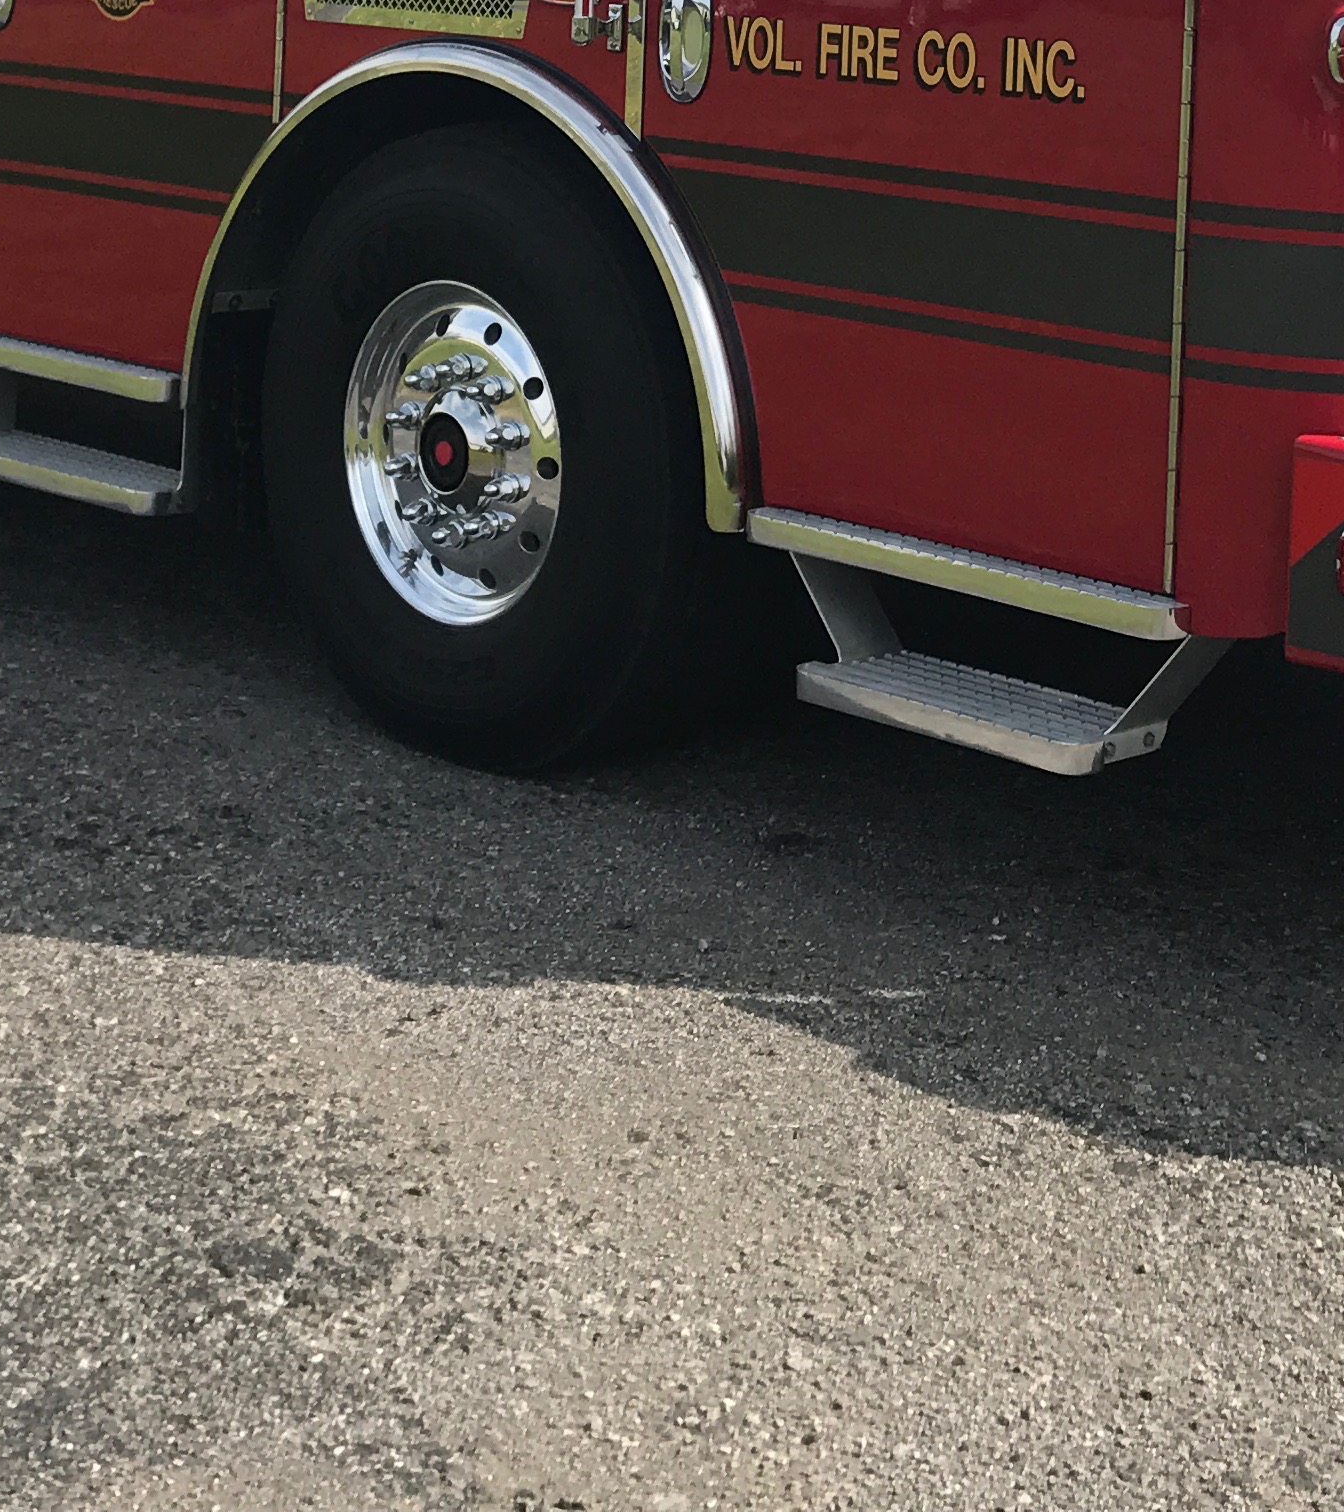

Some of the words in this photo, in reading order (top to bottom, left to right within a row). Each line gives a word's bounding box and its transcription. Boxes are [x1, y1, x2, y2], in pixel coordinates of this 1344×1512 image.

[726, 15, 802, 73] VOL.
[817, 22, 900, 83] FIRE
[915, 29, 985, 92] CO.
[1003, 37, 1086, 103] INC.
